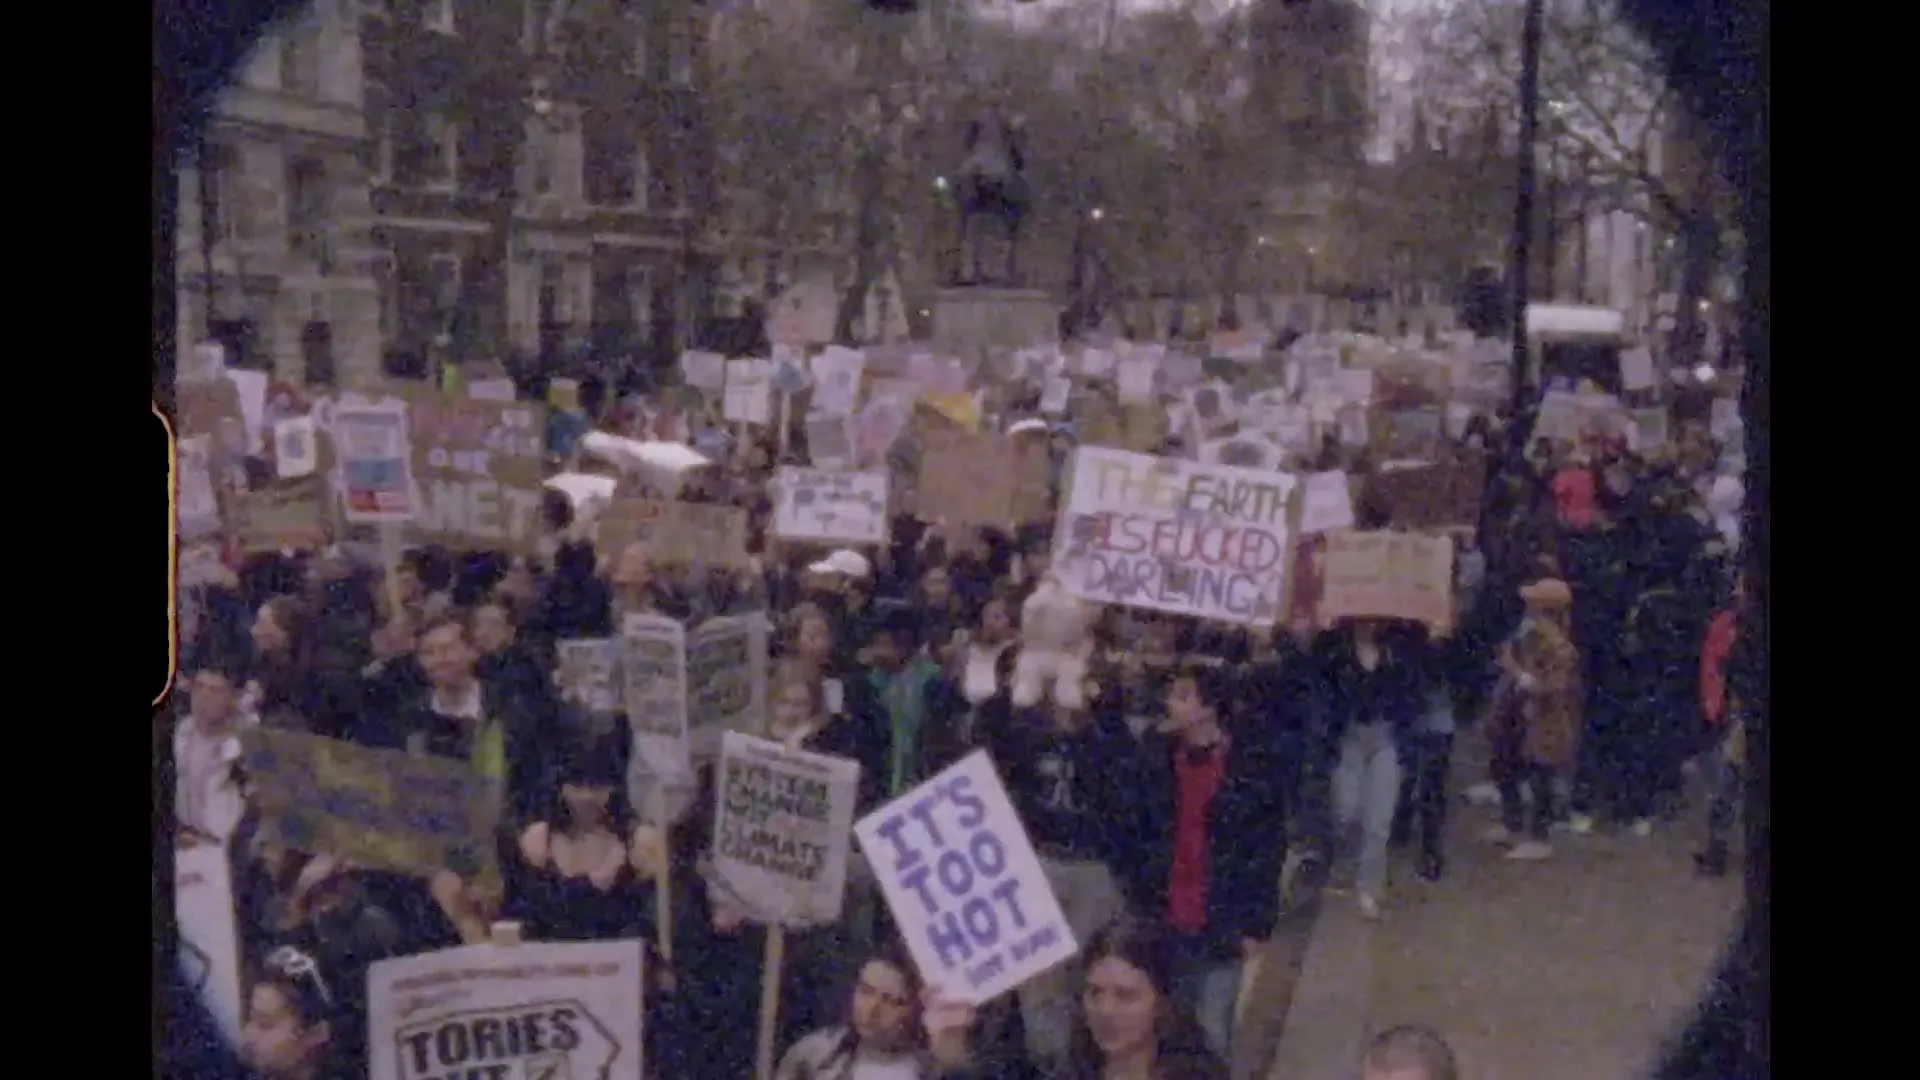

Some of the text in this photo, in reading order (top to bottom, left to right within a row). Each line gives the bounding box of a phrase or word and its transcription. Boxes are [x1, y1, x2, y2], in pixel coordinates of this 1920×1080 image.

[1185, 473, 1287, 522] EARTH
[1096, 510, 1149, 554] IS
[1152, 518, 1280, 572] FUCKED
[1084, 552, 1257, 614] DARLING
[875, 775, 986, 871] IT'S
[901, 831, 1007, 916] TOO
[926, 878, 1027, 969] HOT
[406, 1007, 582, 1074] TORIES
